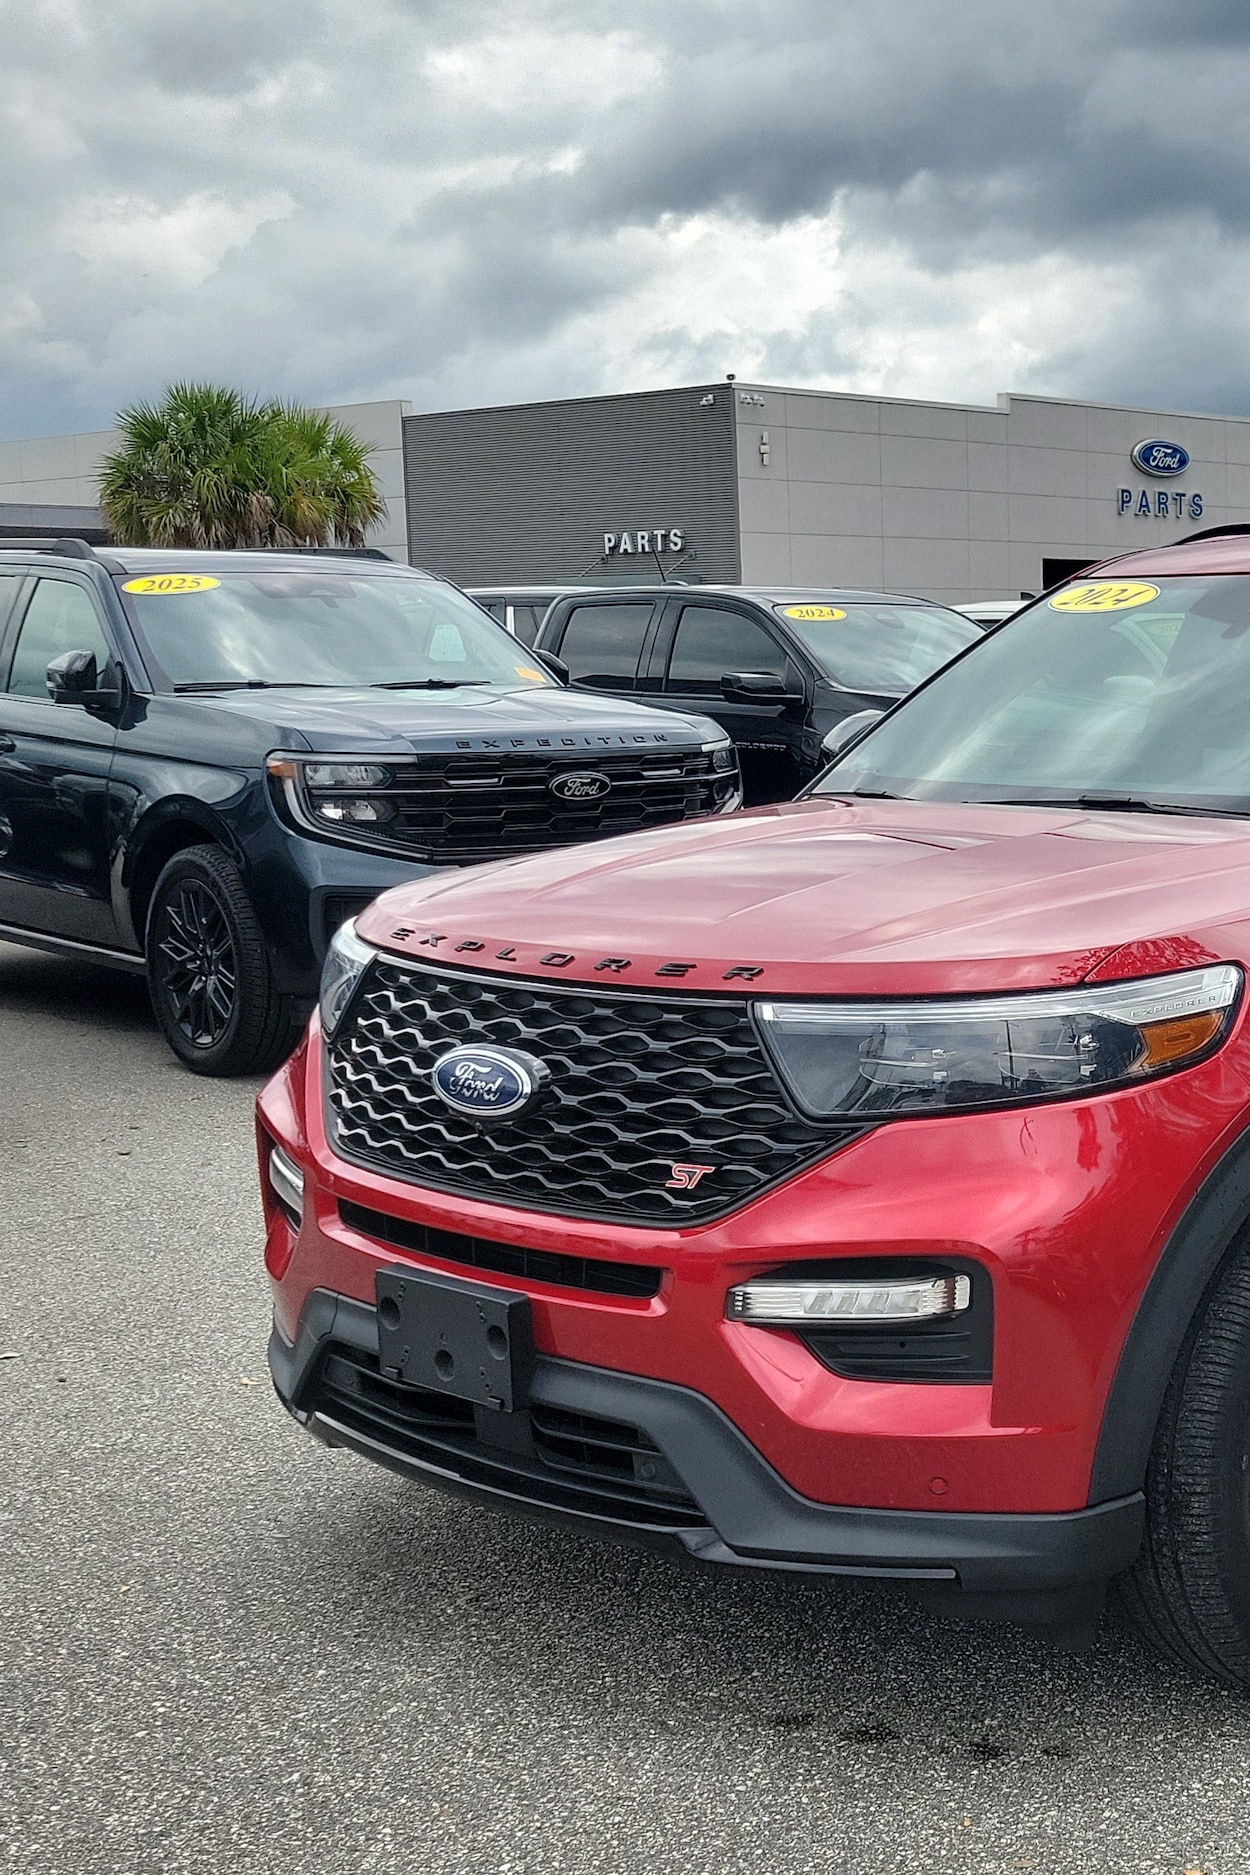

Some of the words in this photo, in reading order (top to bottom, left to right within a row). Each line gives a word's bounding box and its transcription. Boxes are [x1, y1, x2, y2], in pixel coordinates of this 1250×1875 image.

[1149, 446, 1181, 469] Ford
[1117, 487, 1204, 519] PARTS
[604, 528, 683, 555] PARTS
[141, 577, 203, 592] 2025
[1056, 587, 1151, 606] 2024
[795, 608, 836, 618] 2024
[455, 733, 669, 750] EXPEDITION
[563, 777, 601, 797] Ford
[389, 927, 766, 982] EXPLORER
[1131, 995, 1217, 1018] EXPLORER
[449, 1061, 505, 1102] Ford
[665, 1163, 716, 1190] ST
